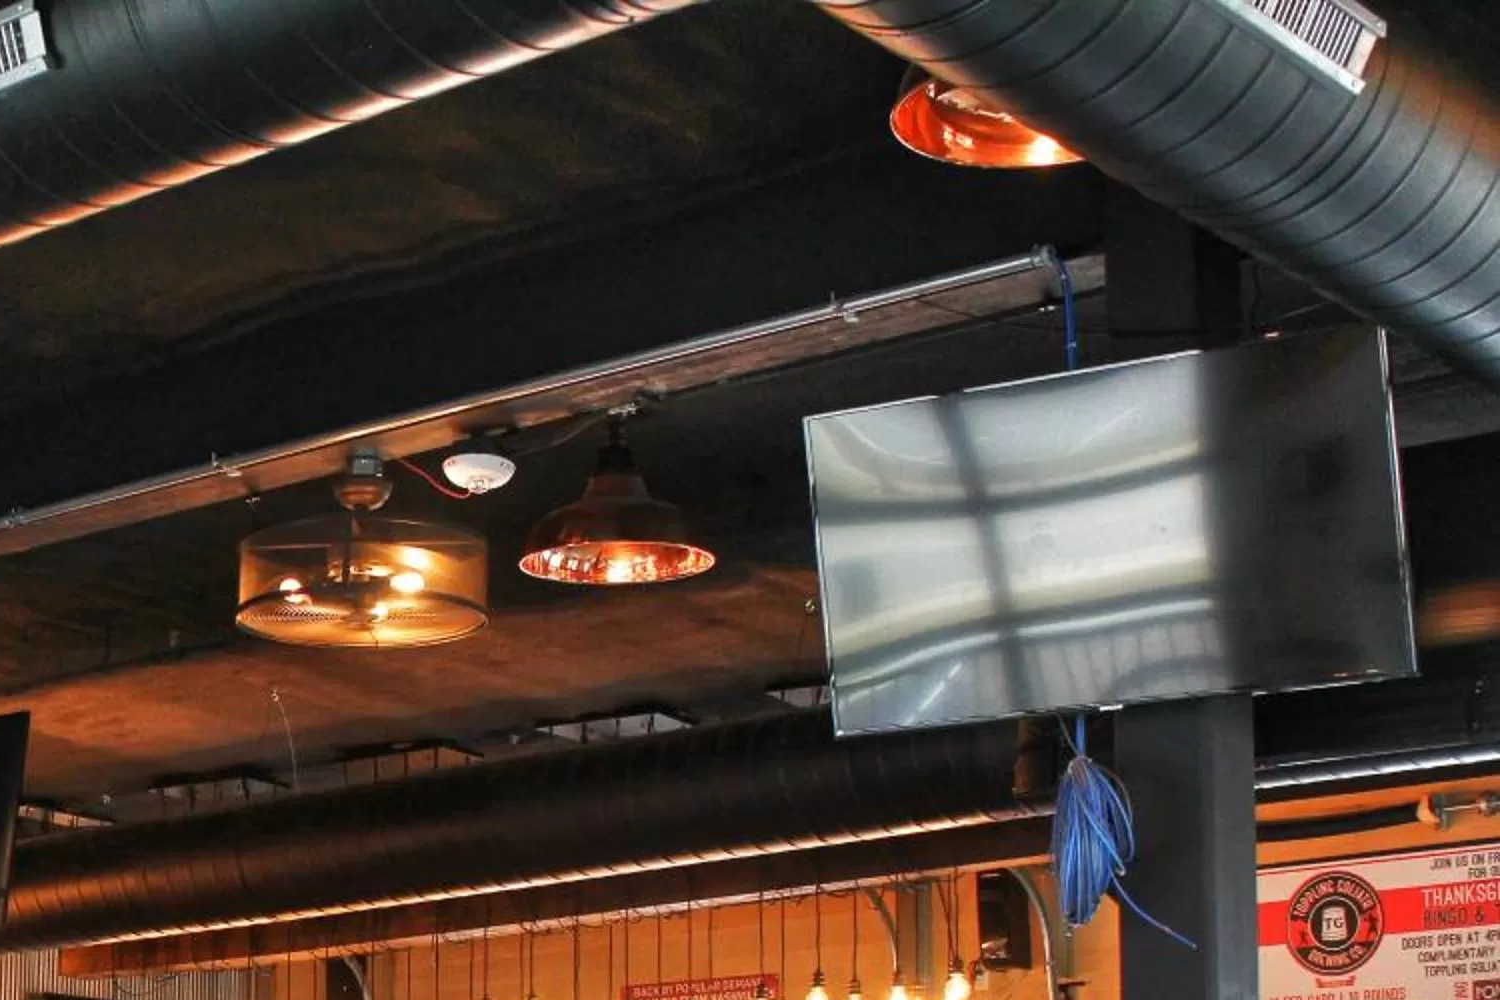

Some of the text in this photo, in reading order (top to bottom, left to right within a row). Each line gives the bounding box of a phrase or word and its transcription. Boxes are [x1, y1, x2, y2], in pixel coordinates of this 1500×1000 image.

[1430, 859, 1452, 871] JOIN
[1456, 856, 1469, 867] US
[1473, 853, 1485, 864] ON
[1468, 867, 1486, 878] FOR
[1293, 880, 1375, 918] TOPPLING GOLIATH
[1325, 917, 1345, 931] TG
[1423, 907, 1484, 929] BINGO &
[1402, 937, 1433, 950] DOORS
[1437, 934, 1462, 947] OPEN
[1466, 932, 1480, 944] AT
[1417, 946, 1495, 963] COMPLIMENTARY
[1424, 959, 1500, 978] TOPPLING GOLIA
[633, 985, 659, 998] BACK
[661, 984, 673, 996] BY
